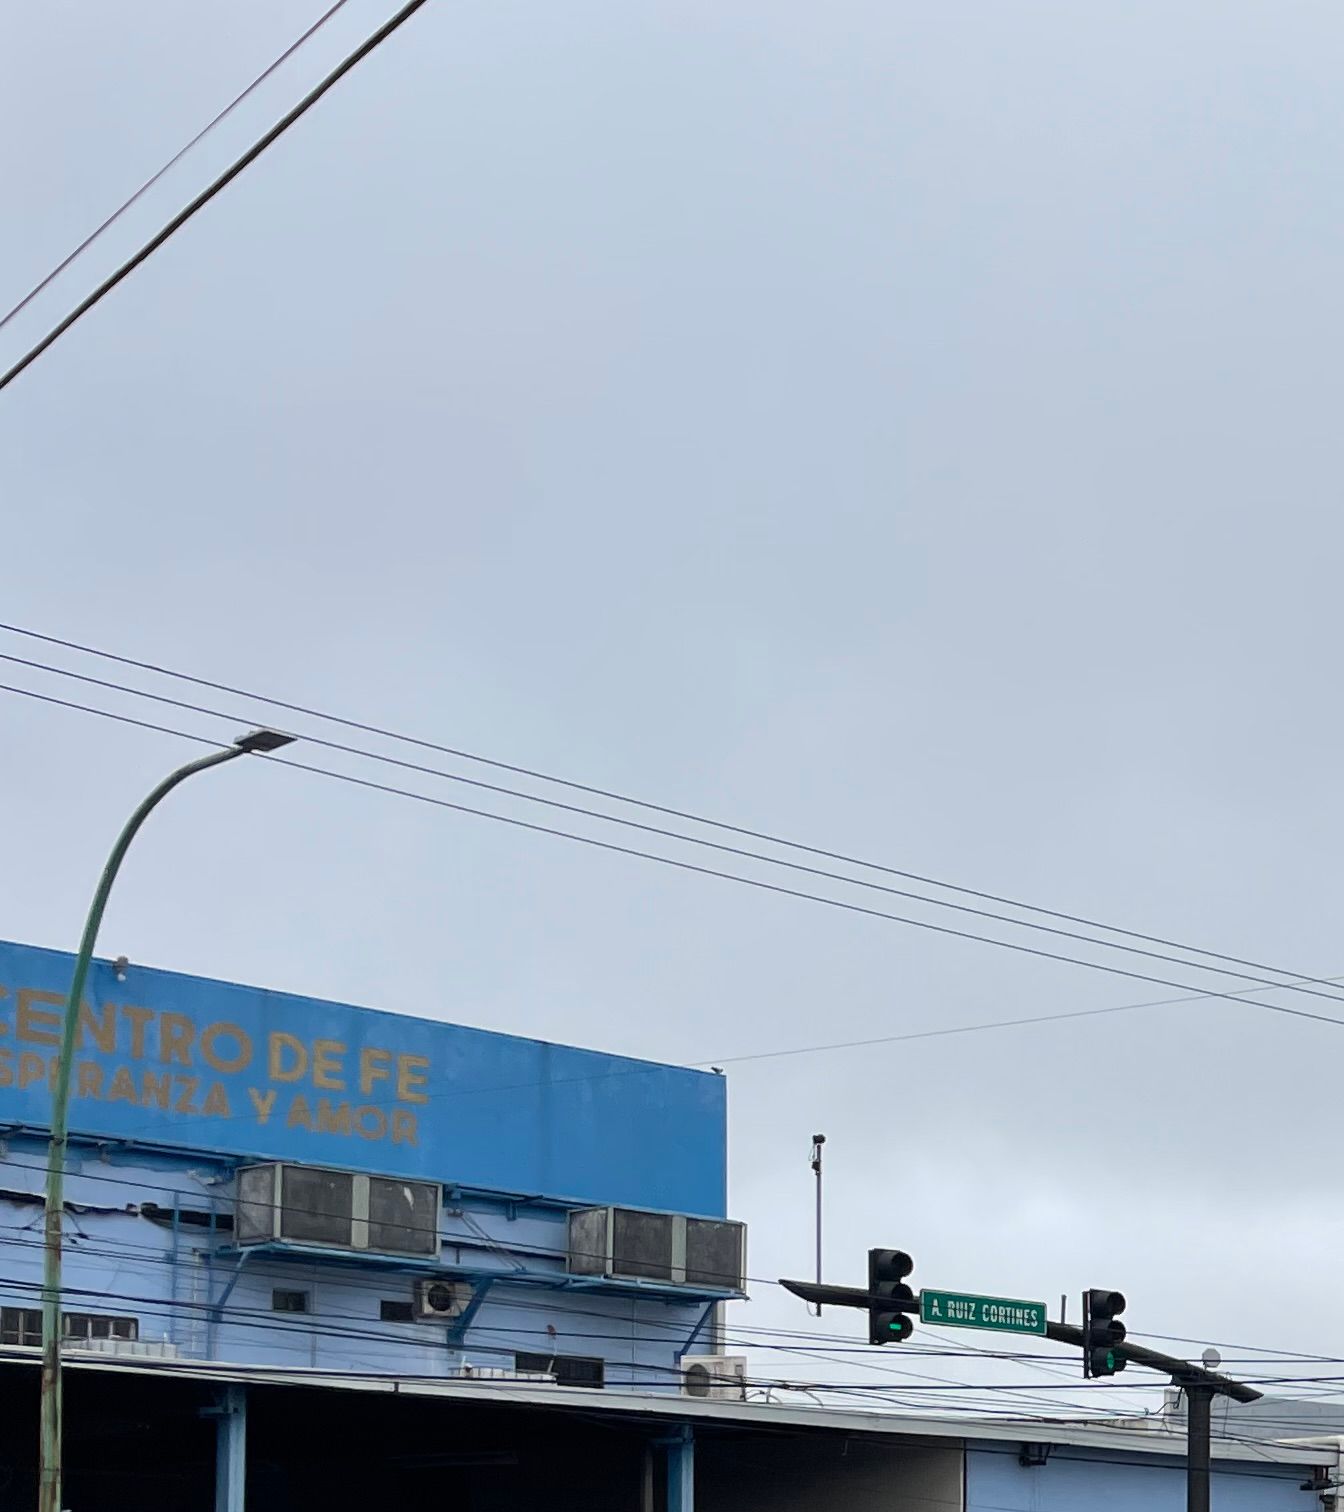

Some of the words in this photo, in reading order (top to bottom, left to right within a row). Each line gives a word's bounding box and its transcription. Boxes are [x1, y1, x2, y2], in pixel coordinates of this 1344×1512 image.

[0, 984, 253, 1074] ENTRO
[268, 1031, 347, 1092] DE
[360, 1047, 430, 1104] FE
[249, 1086, 277, 1125] Y
[287, 1099, 419, 1148] AMOR
[947, 1300, 976, 1321] RUIZ
[982, 1304, 1039, 1328] CORTINES
